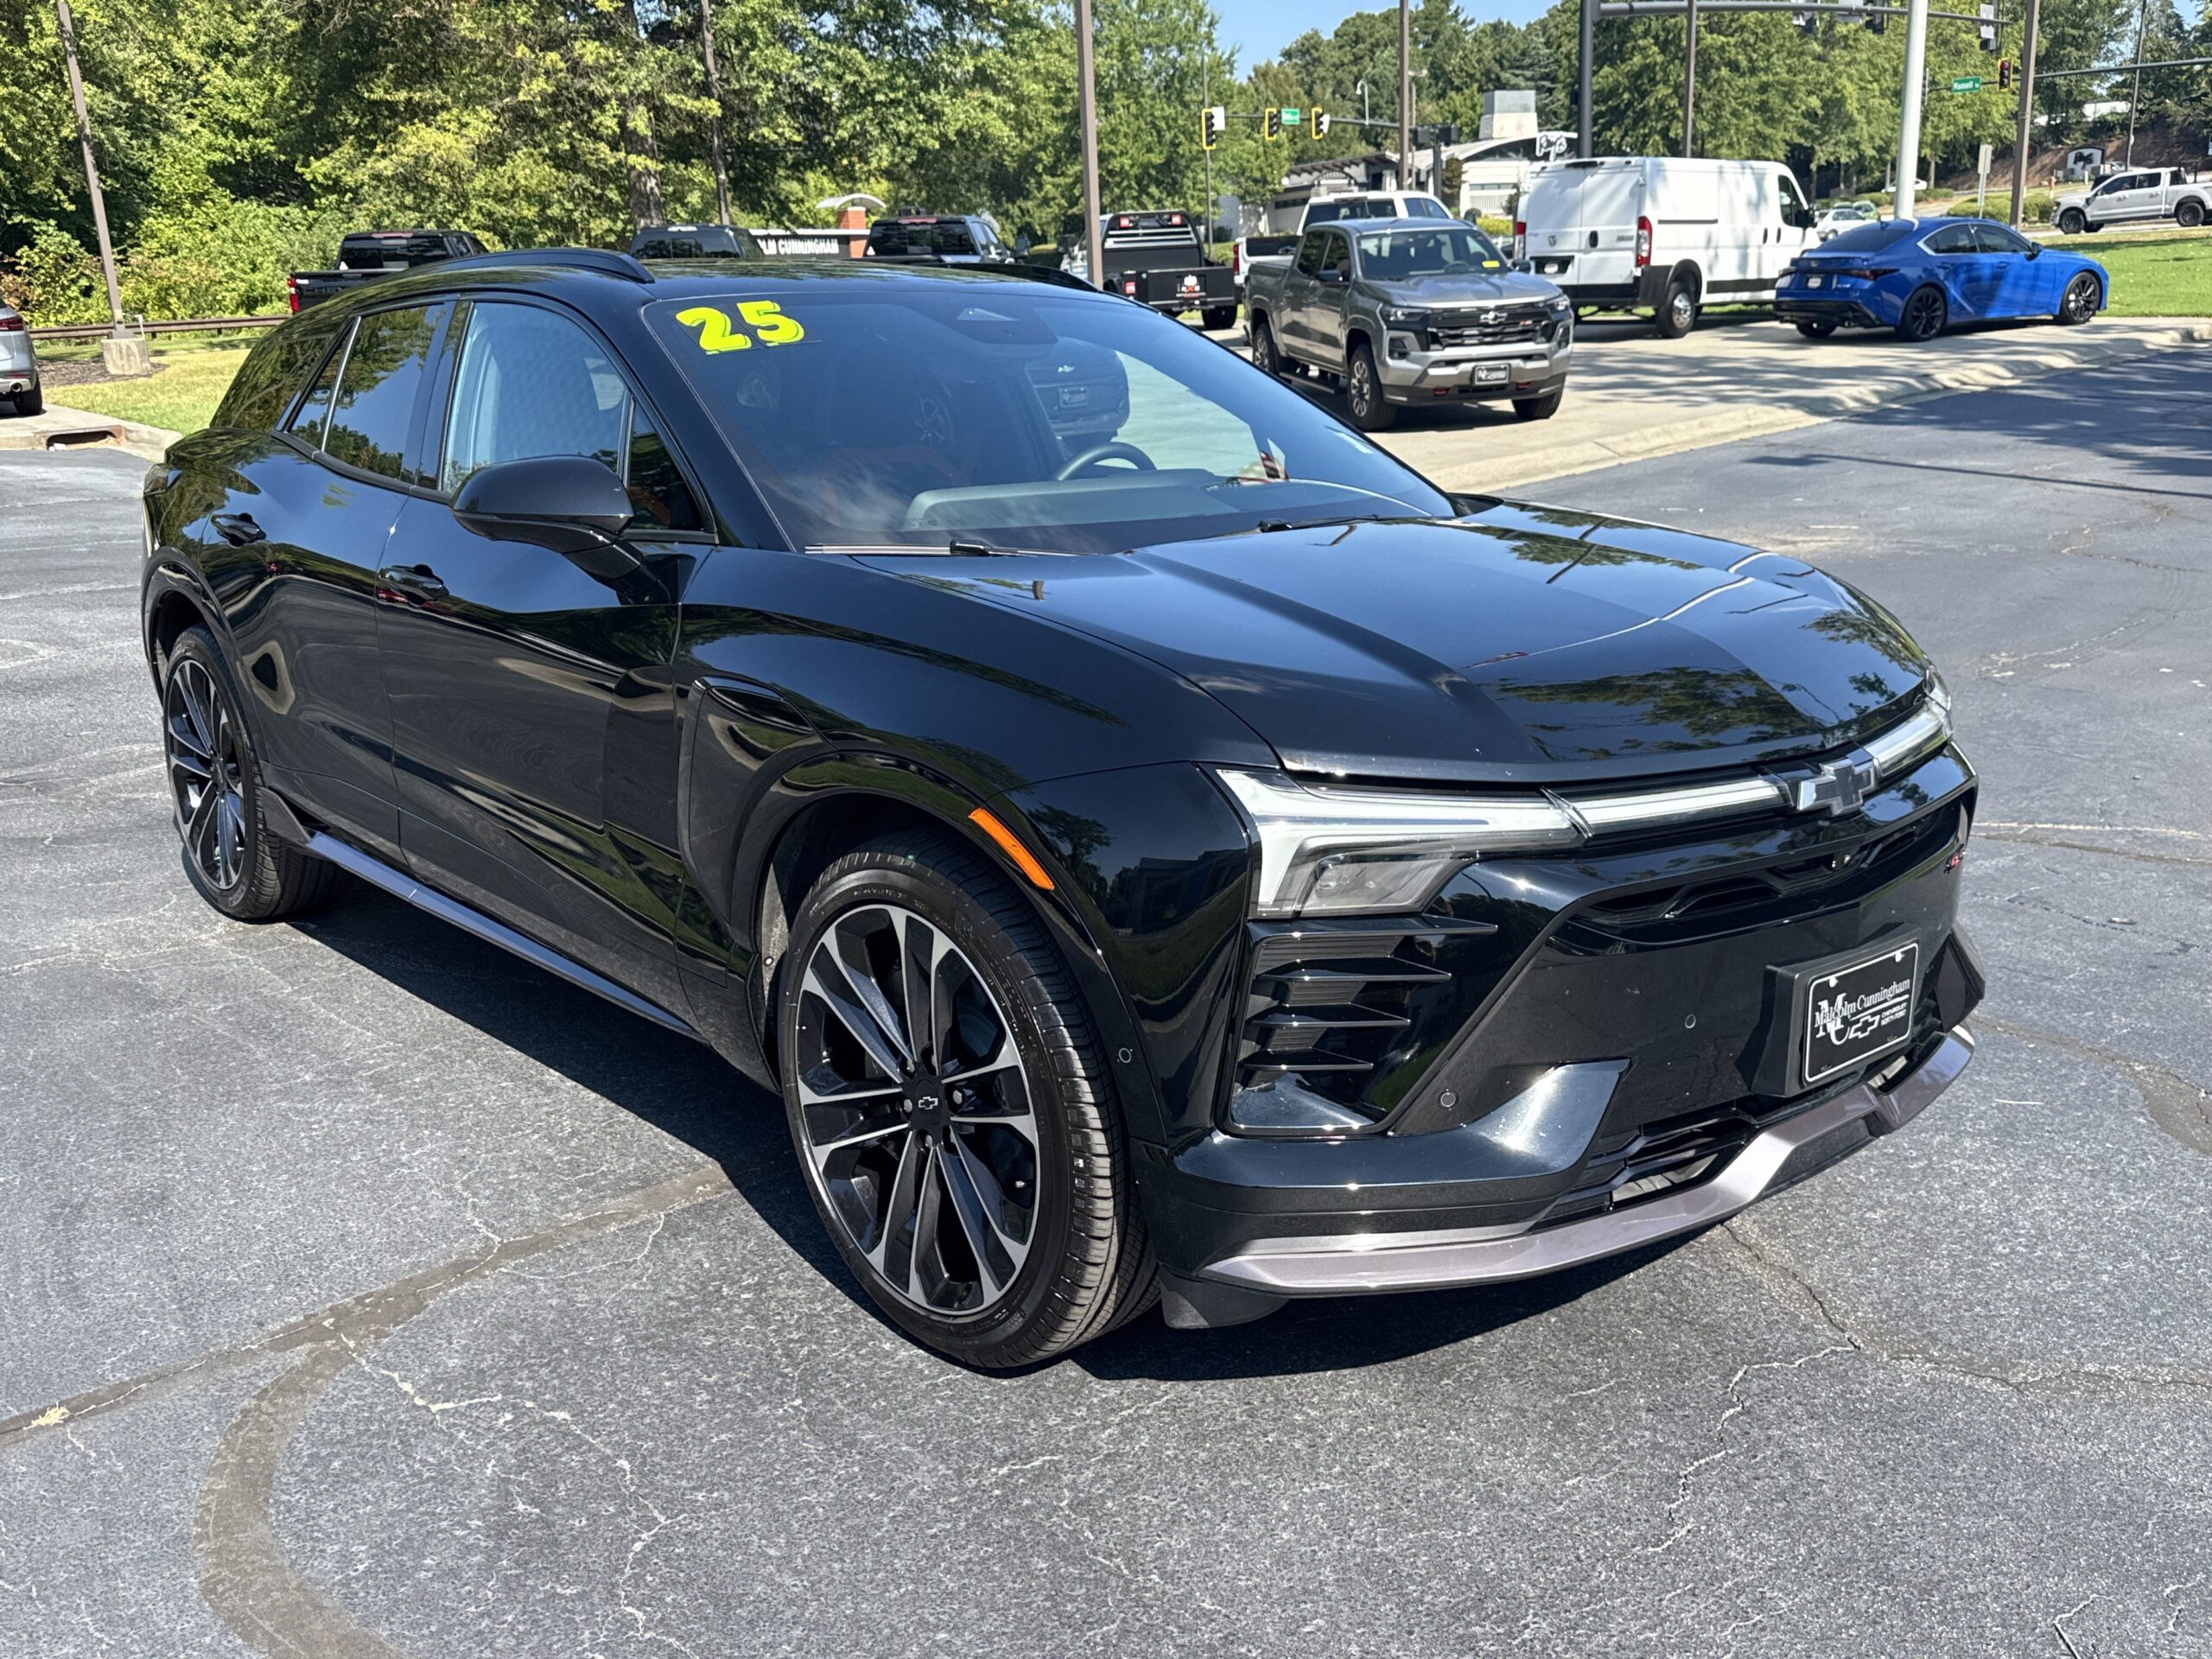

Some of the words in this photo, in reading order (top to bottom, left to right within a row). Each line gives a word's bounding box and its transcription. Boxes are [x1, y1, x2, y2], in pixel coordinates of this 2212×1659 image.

[778, 238, 840, 255] CUNNINGHAM
[676, 300, 804, 353] 25
[1815, 1000, 1857, 1028] Malcolm
[1857, 978, 1910, 1010] Cunningham
[1881, 1002, 1908, 1019] CHEVROLET
